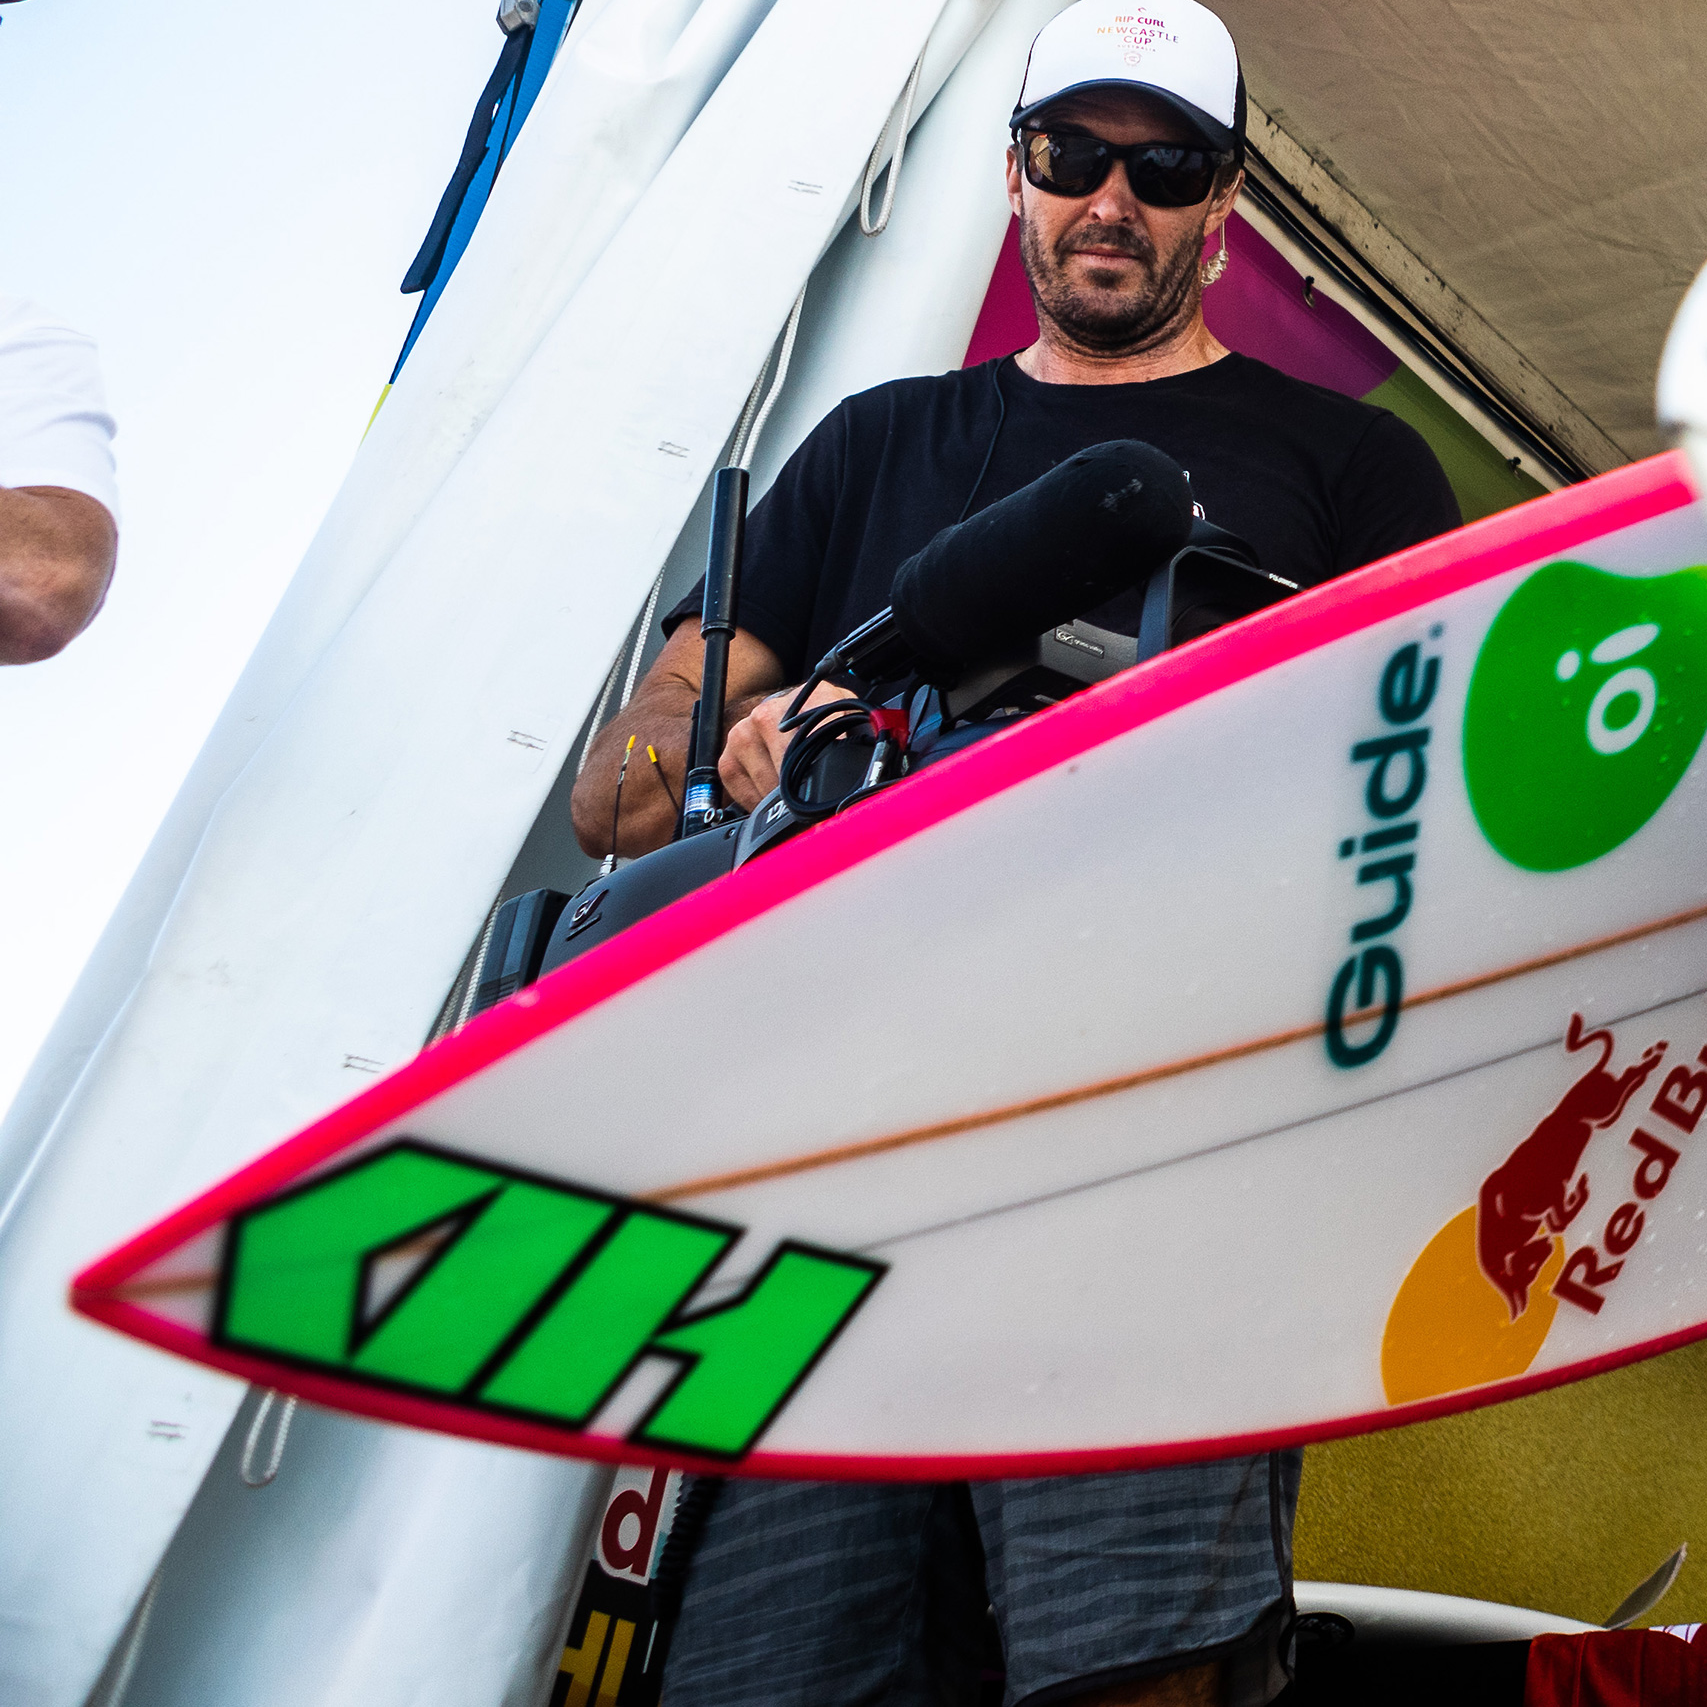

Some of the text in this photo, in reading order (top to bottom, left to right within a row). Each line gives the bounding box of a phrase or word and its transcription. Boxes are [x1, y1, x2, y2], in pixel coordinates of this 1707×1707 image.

[1115, 15, 1165, 28] RIP CURL
[1096, 26, 1180, 44] NEWCASTLE
[1123, 35, 1152, 45] CUP
[1552, 1126, 1682, 1316] Red
